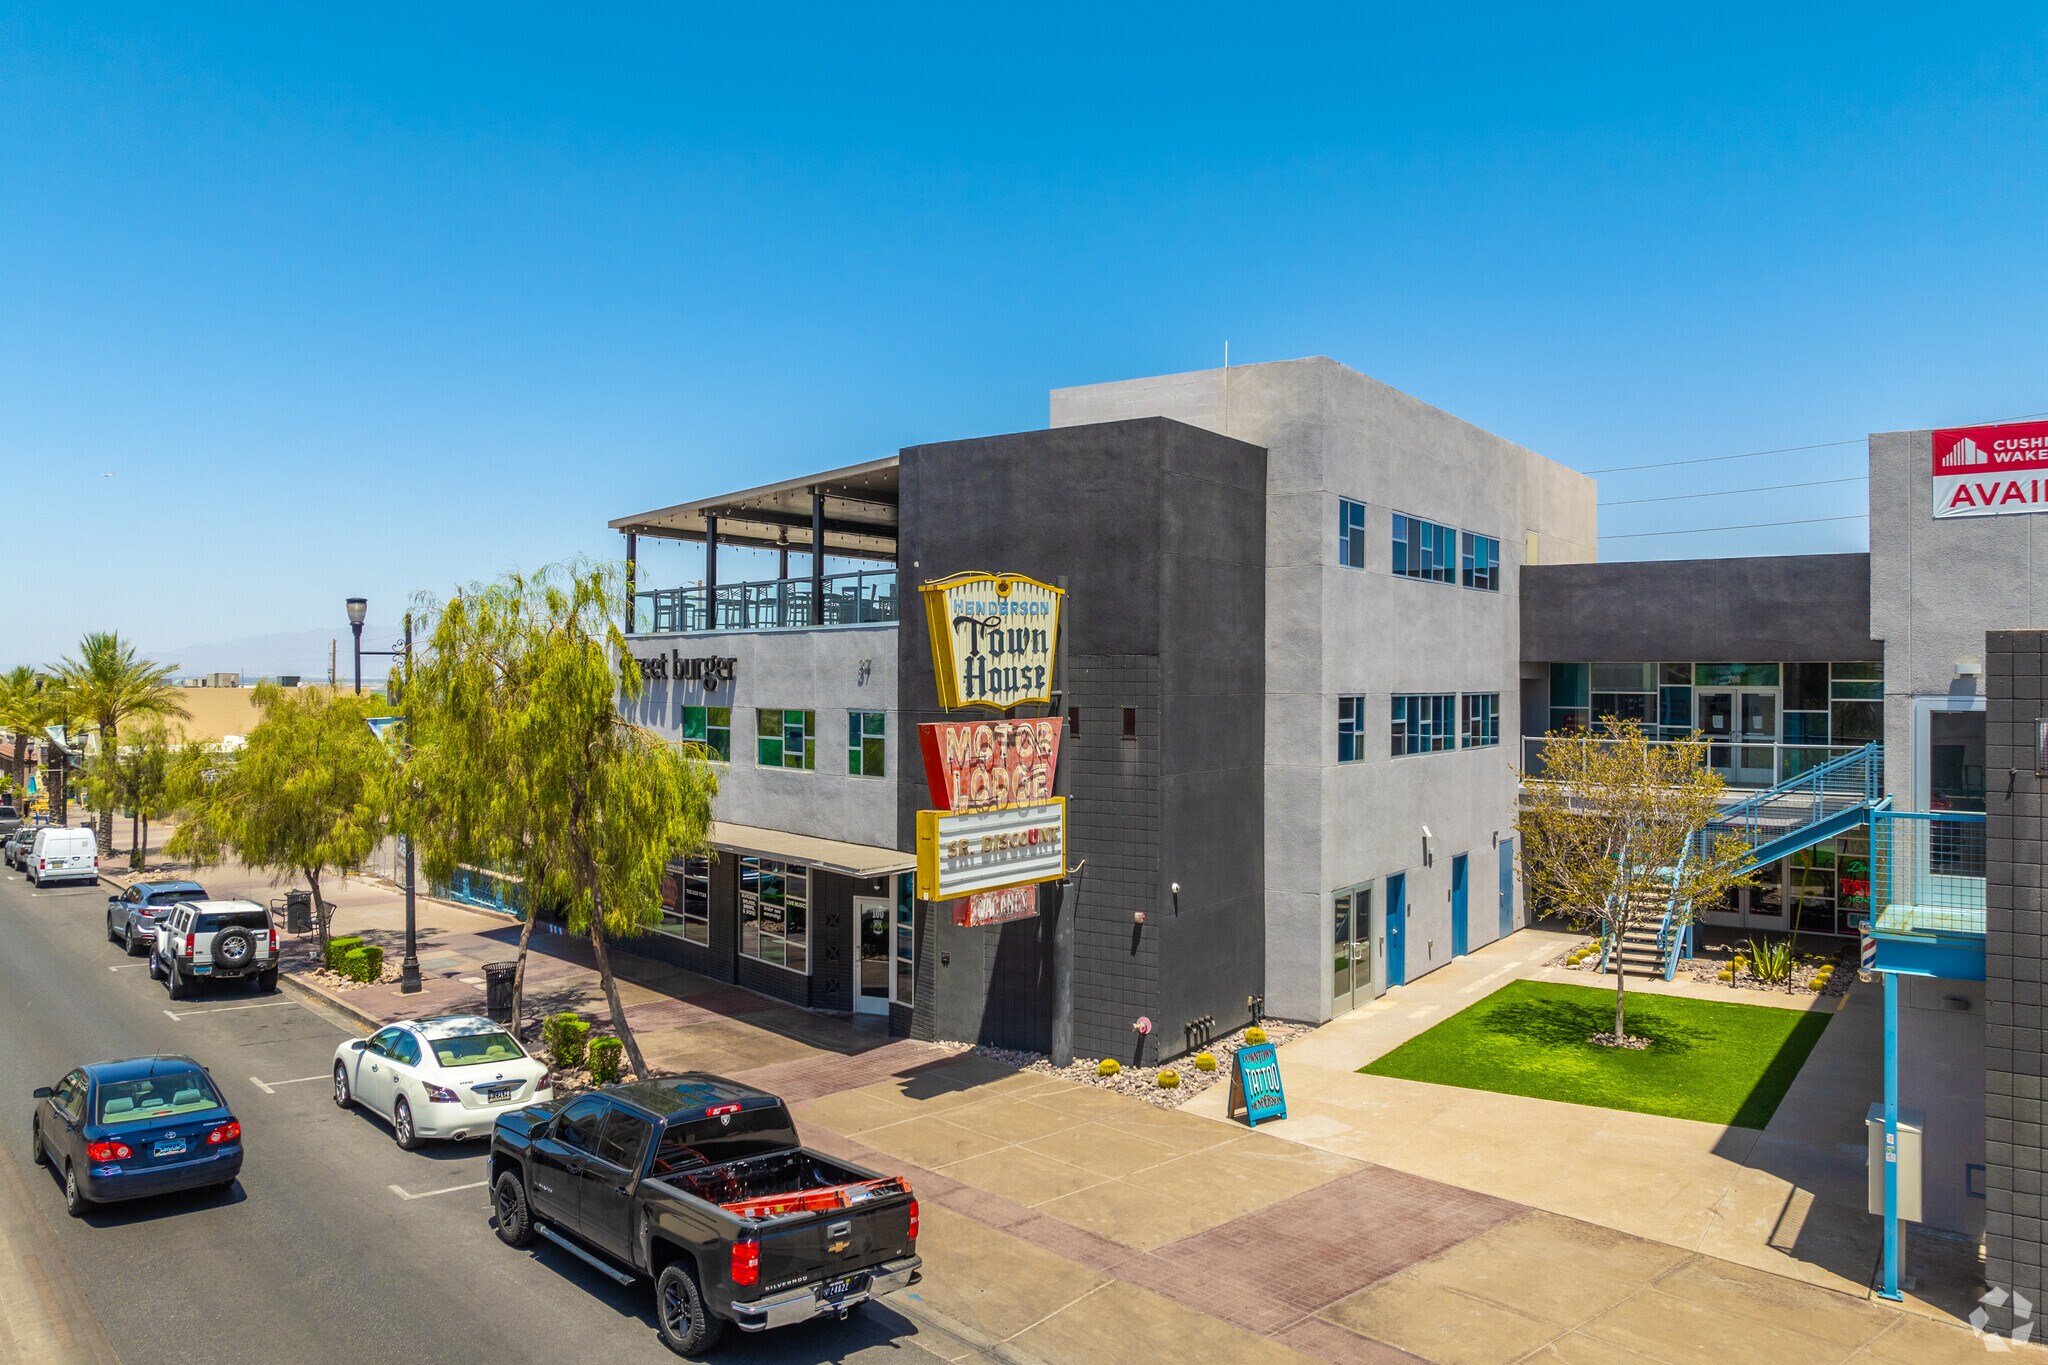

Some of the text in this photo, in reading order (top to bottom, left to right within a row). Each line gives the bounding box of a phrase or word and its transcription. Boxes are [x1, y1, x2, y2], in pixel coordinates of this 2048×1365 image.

[1993, 437, 2048, 450] CUSH
[953, 599, 1049, 616] HENDERSON
[952, 616, 1049, 658] Town
[673, 649, 737, 691] burger
[963, 654, 1046, 699] House
[1727, 675, 1741, 684] 200
[946, 721, 1055, 764] MOTOR
[953, 764, 1049, 810] LODGE
[947, 826, 1060, 858] SR. DISCOUNT
[872, 910, 884, 919] 100
[977, 890, 1029, 919] VACANCY
[1245, 1063, 1280, 1097] TATTOO
[765, 1276, 808, 1291] SILVERADO
